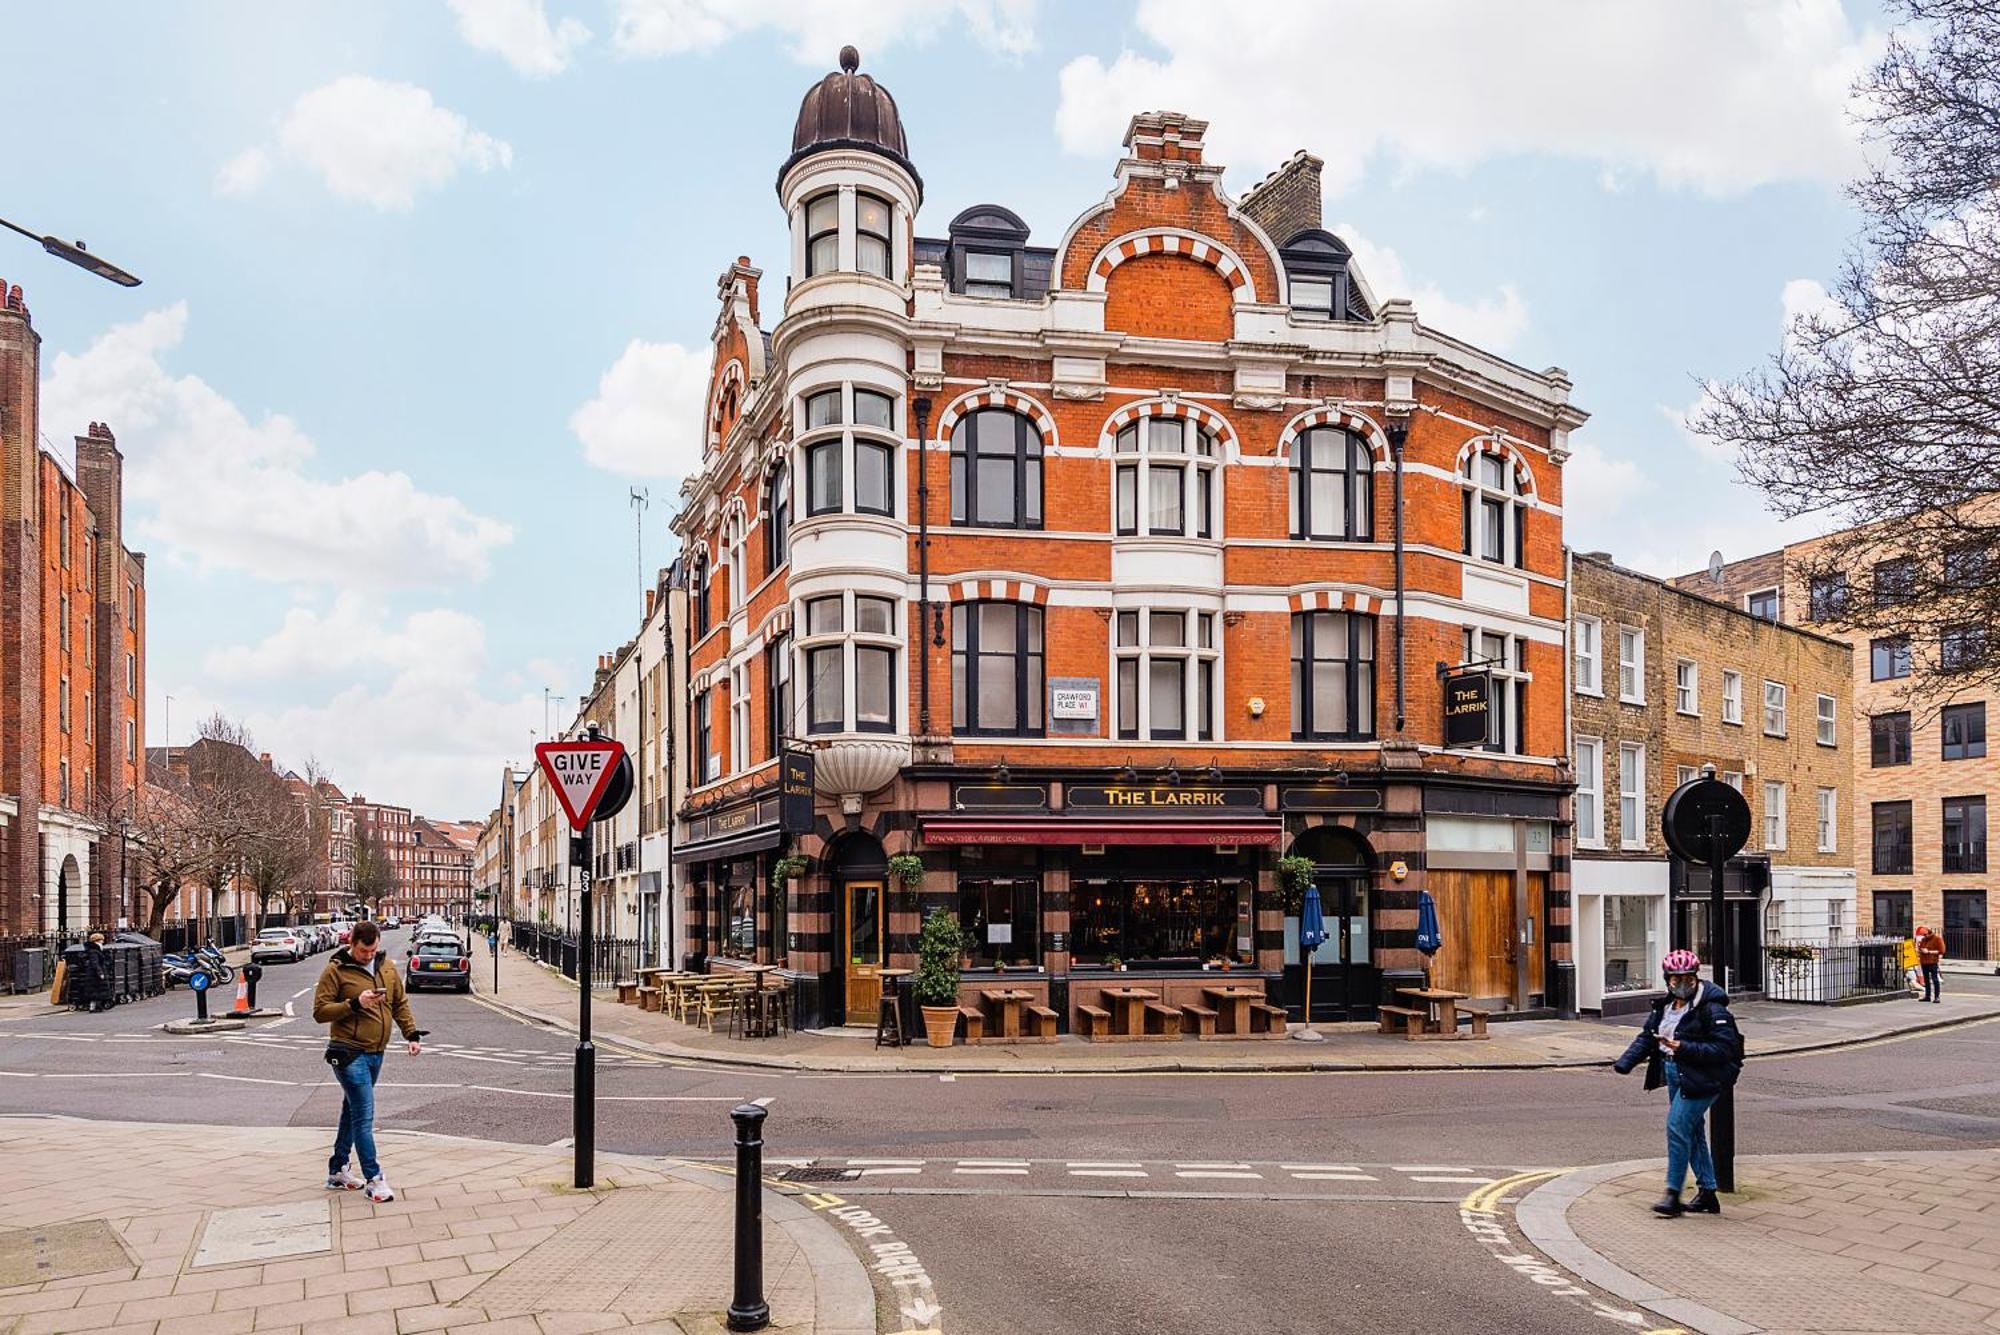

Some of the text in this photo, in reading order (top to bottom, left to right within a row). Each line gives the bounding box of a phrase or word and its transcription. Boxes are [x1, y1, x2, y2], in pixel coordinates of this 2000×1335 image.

[1057, 693, 1092, 701] CRAWFORD
[1455, 690, 1479, 701] THE
[1057, 701, 1088, 709] PLACE W1
[1446, 701, 1488, 716] LARRIK
[554, 753, 601, 771] GIVE
[563, 774, 593, 785] WAY
[790, 768, 807, 781] THE
[784, 782, 813, 797] LARRIK
[1104, 790, 1225, 805] THE LARRIK
[828, 1205, 932, 1289] LOOK RIGHT
[1459, 1209, 1590, 1296] LOOK LEFT
